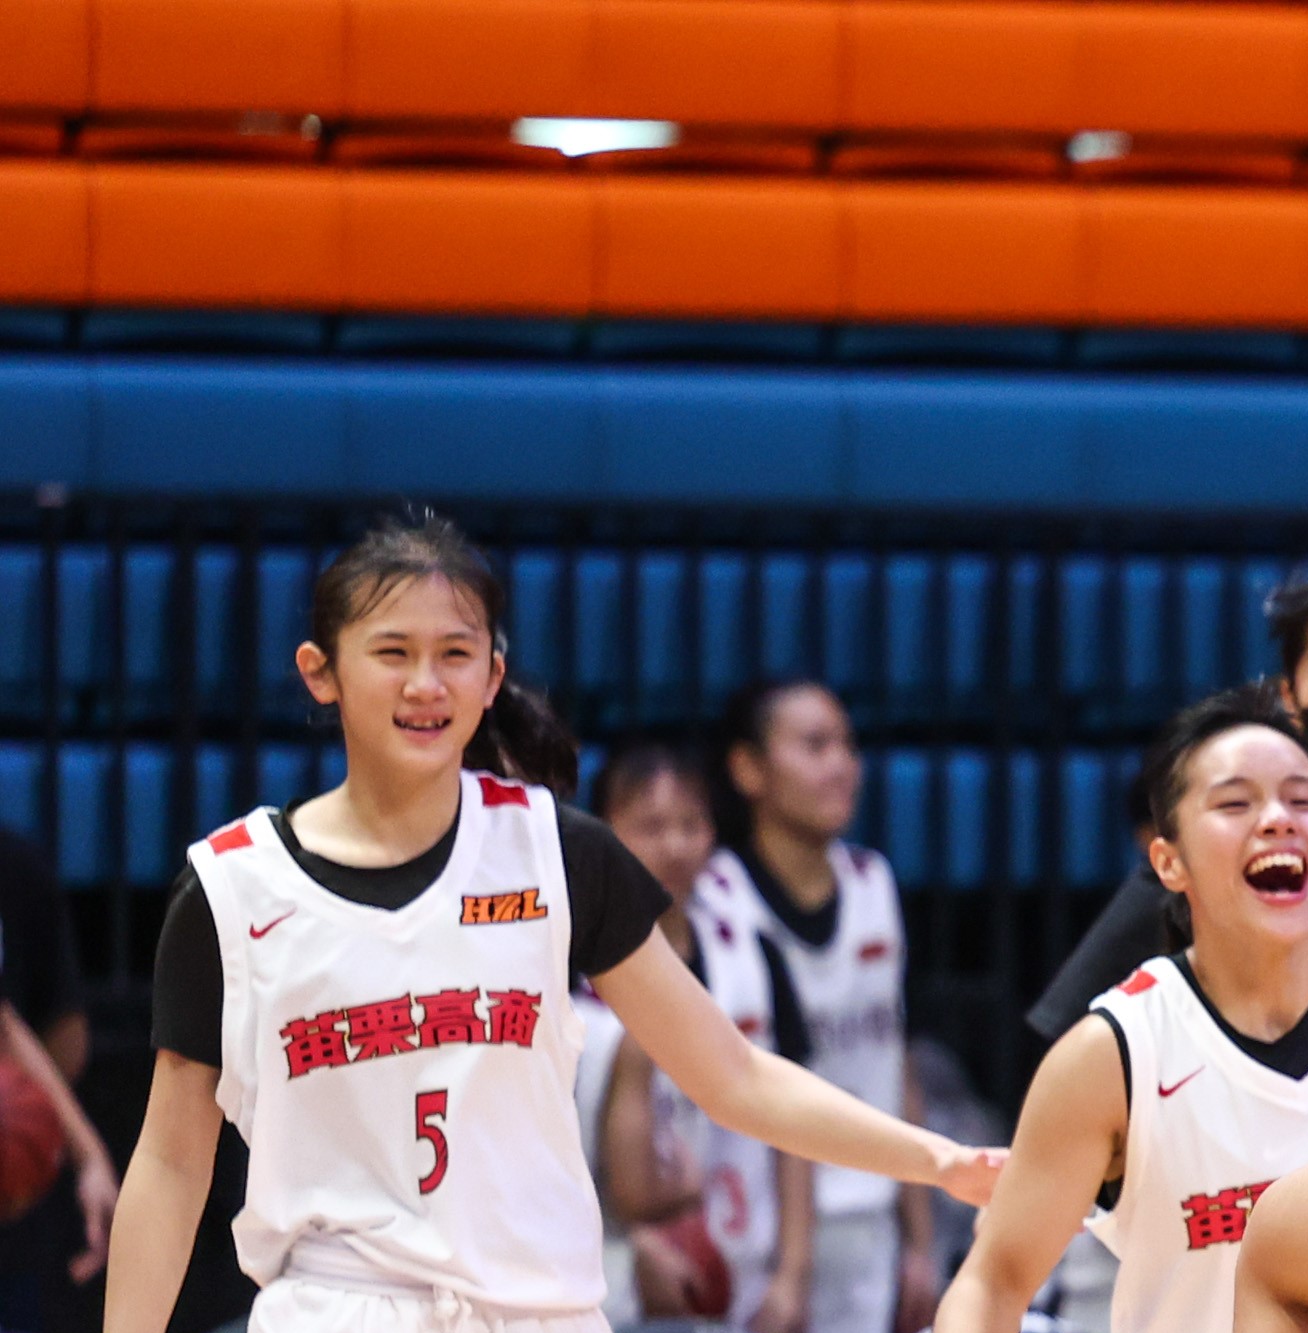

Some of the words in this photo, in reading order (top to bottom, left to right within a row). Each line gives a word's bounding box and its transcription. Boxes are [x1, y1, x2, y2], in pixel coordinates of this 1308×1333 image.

[279, 986, 542, 1080] 苗栗高商
[415, 1088, 448, 1196] 5
[1181, 1179, 1276, 1252] 苗
